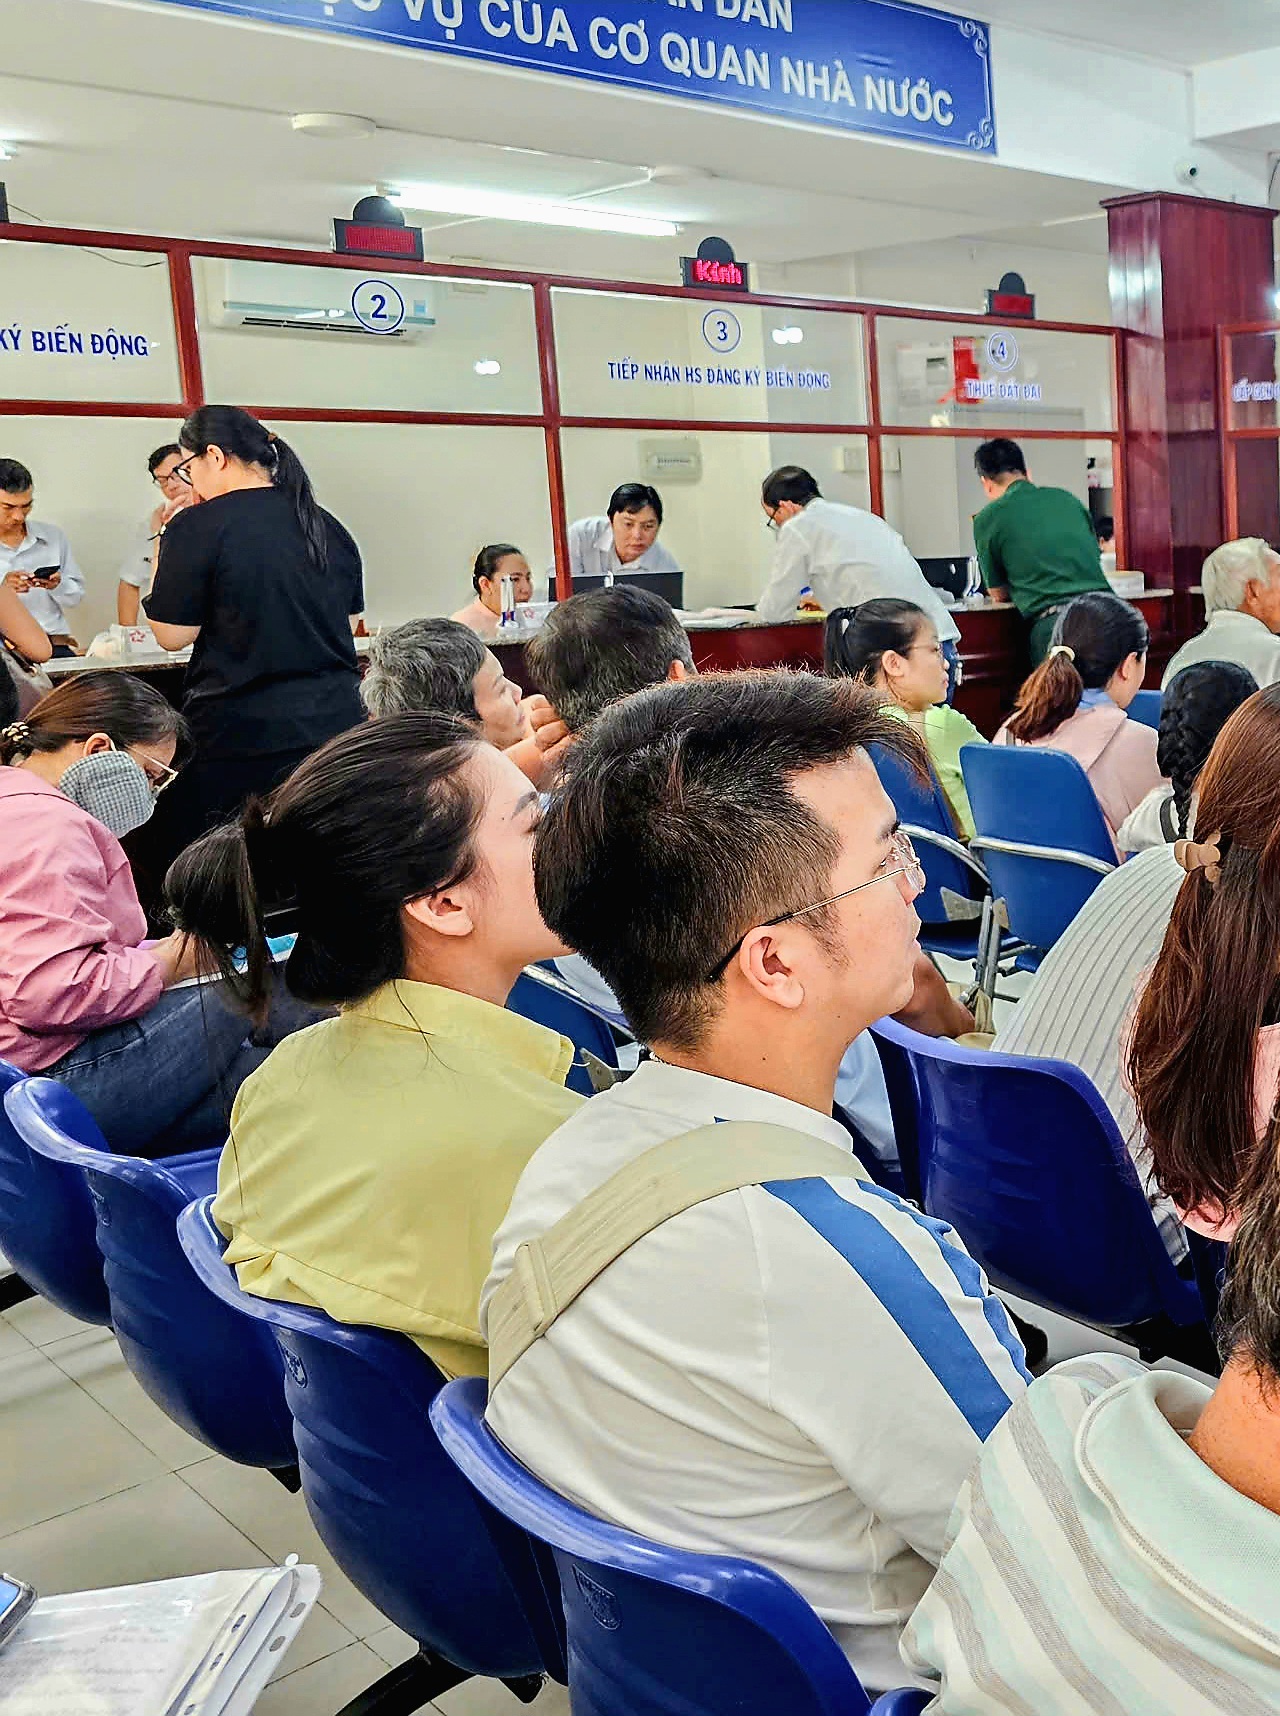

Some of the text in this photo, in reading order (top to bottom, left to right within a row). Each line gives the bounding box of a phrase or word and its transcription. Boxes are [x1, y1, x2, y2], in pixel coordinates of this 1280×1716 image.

[479, 0, 578, 53] CỦA
[588, 16, 649, 65] CƠ
[659, 31, 770, 90] QUAN
[780, 55, 856, 107] NHÀ
[864, 73, 954, 127] NƯỚC
[371, 294, 387, 319] 2
[32, 323, 83, 353] BIẾN
[90, 328, 148, 360] ĐỘNG
[716, 321, 728, 341] 3
[997, 341, 1007, 360] 4
[608, 356, 639, 380] TIẾP
[644, 360, 680, 386] NHẬN
[685, 366, 702, 383] HS
[745, 365, 760, 385] KÝ
